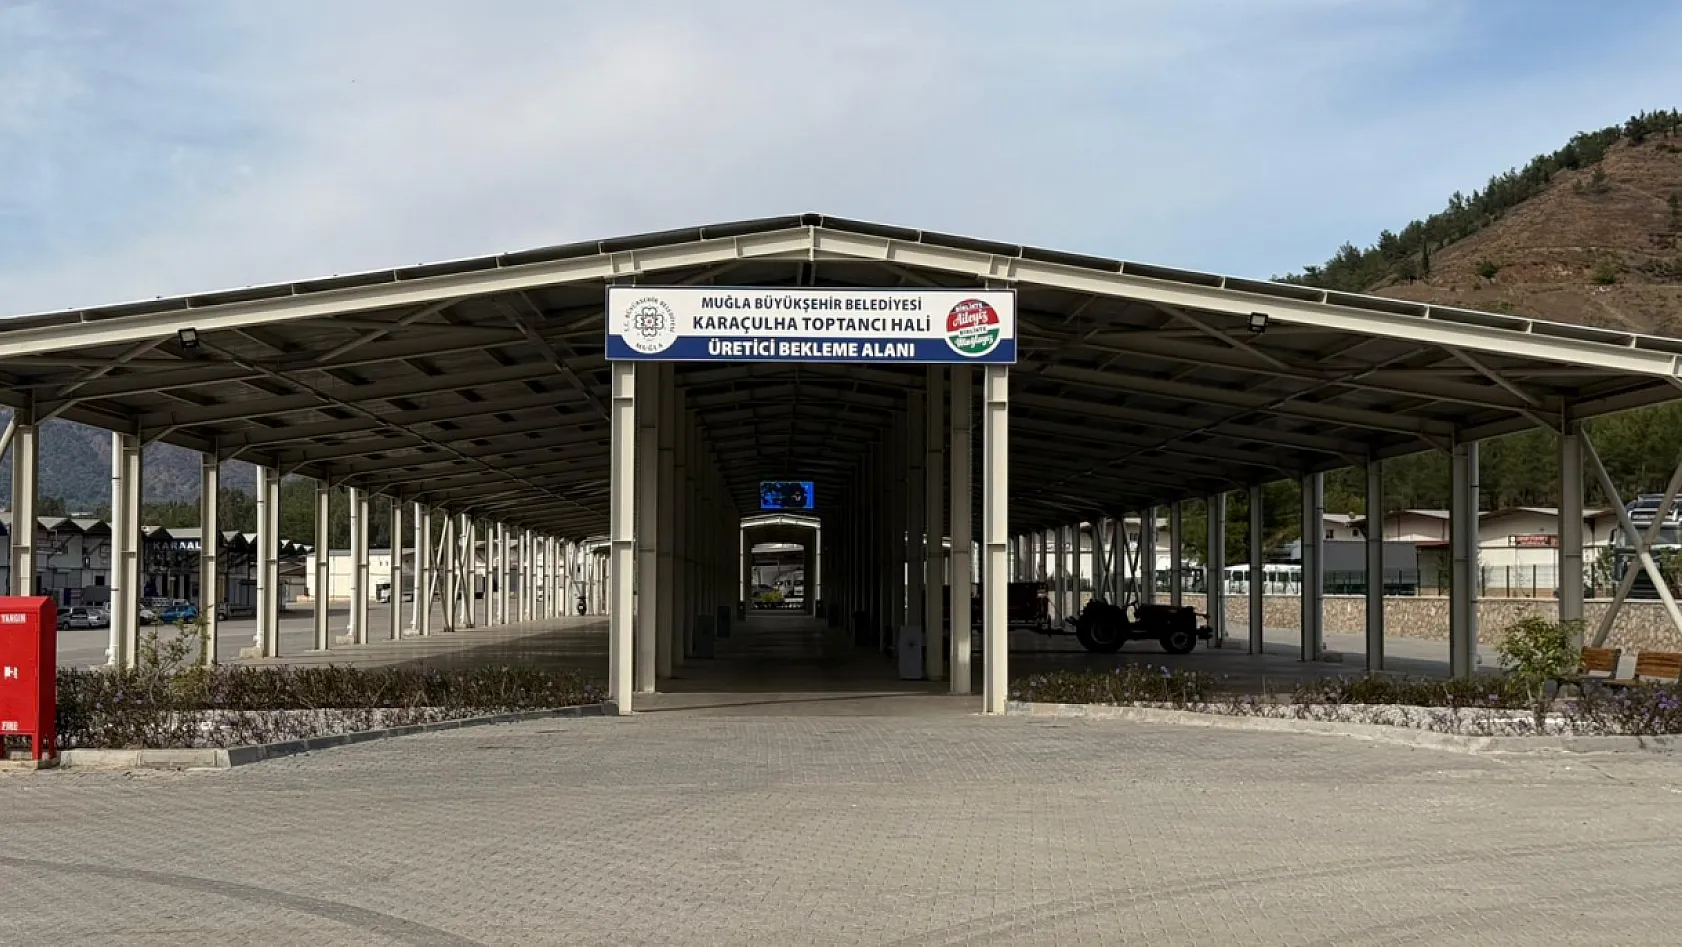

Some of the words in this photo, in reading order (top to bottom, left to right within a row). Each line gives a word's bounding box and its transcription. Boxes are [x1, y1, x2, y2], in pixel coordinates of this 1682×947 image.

[701, 294, 751, 309] MUĞLA
[754, 295, 842, 313] BÜYÜKŞEHİR
[845, 296, 922, 311] BELEDİYESİ
[693, 315, 798, 334] KARAÇULHA
[802, 317, 887, 331] TOPTANCI
[891, 314, 931, 332] HALİ
[708, 337, 776, 356] ÜRETİCİ
[779, 341, 859, 357] BEKLEME
[861, 343, 916, 357] ALANI
